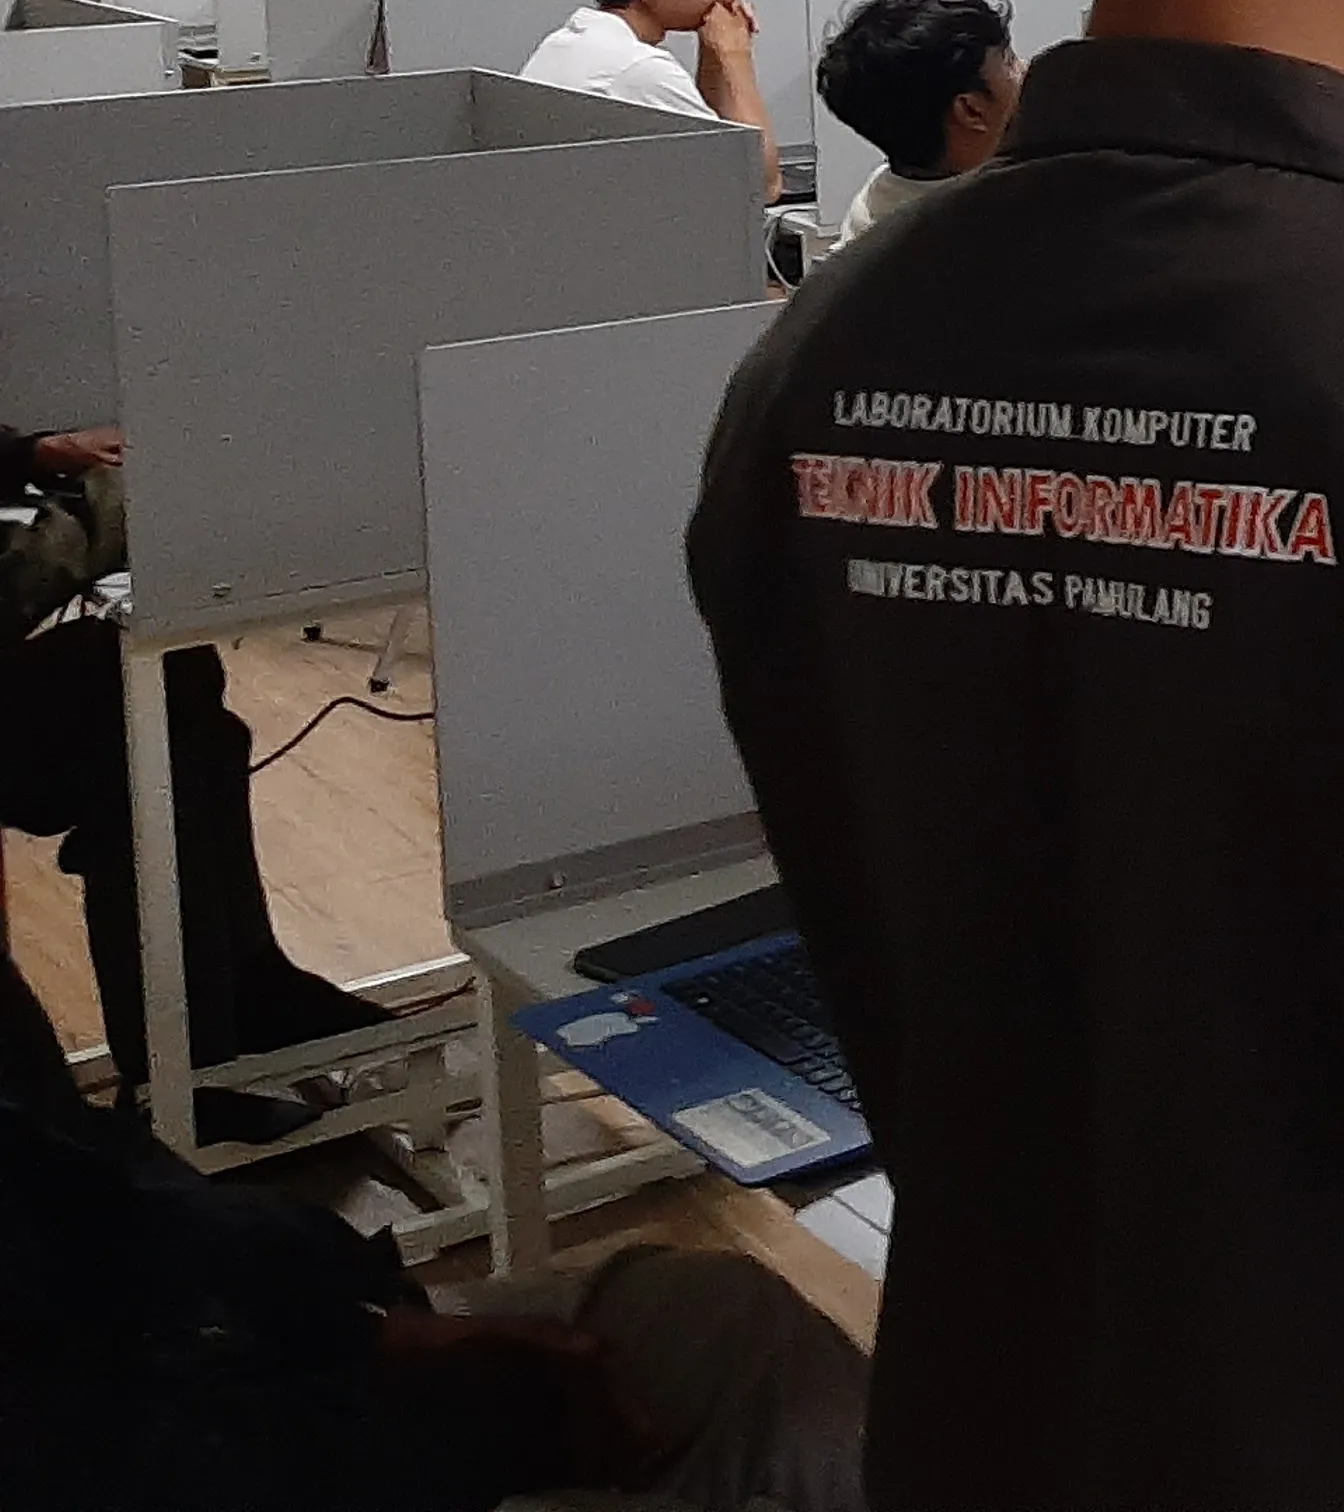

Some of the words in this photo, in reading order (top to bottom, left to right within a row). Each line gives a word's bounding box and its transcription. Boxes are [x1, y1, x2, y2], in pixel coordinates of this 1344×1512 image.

[833, 390, 1073, 440] LABORATORIUM
[1082, 406, 1257, 452] KOMPUTER
[954, 464, 1338, 566] INFORMATIKA
[847, 558, 1054, 607] IVERSITAS
